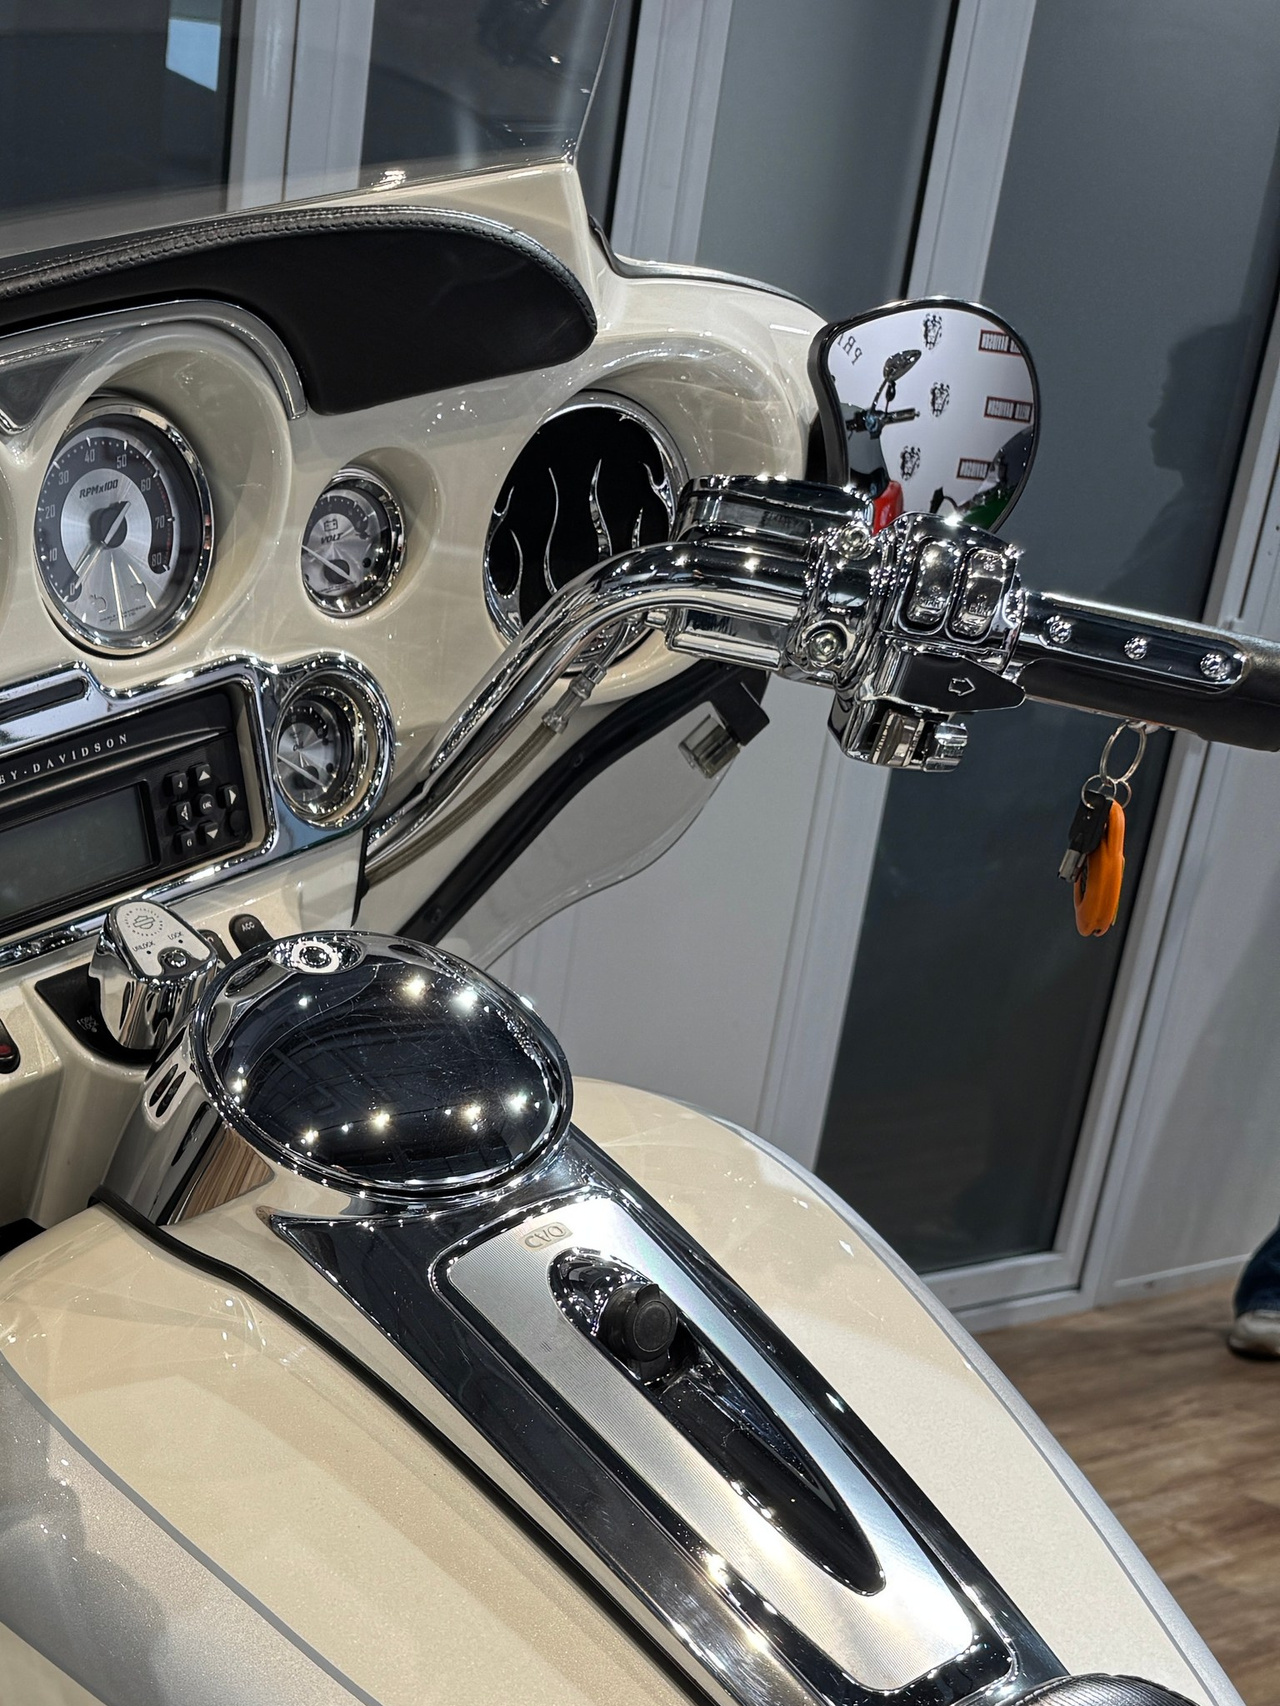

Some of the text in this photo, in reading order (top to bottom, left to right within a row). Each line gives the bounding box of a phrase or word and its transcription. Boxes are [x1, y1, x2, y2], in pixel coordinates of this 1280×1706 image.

[84, 449, 96, 463] 40
[116, 454, 128, 468] 50
[58, 470, 69, 485] 30
[140, 477, 151, 491] 60
[45, 504, 56, 519] 20
[155, 518, 165, 529] 70
[321, 532, 343, 545] VOLT
[49, 548, 58, 561] 10
[151, 552, 162, 566] 80
[167, 931, 185, 941] LOCK
[524, 1226, 567, 1248] CVO
